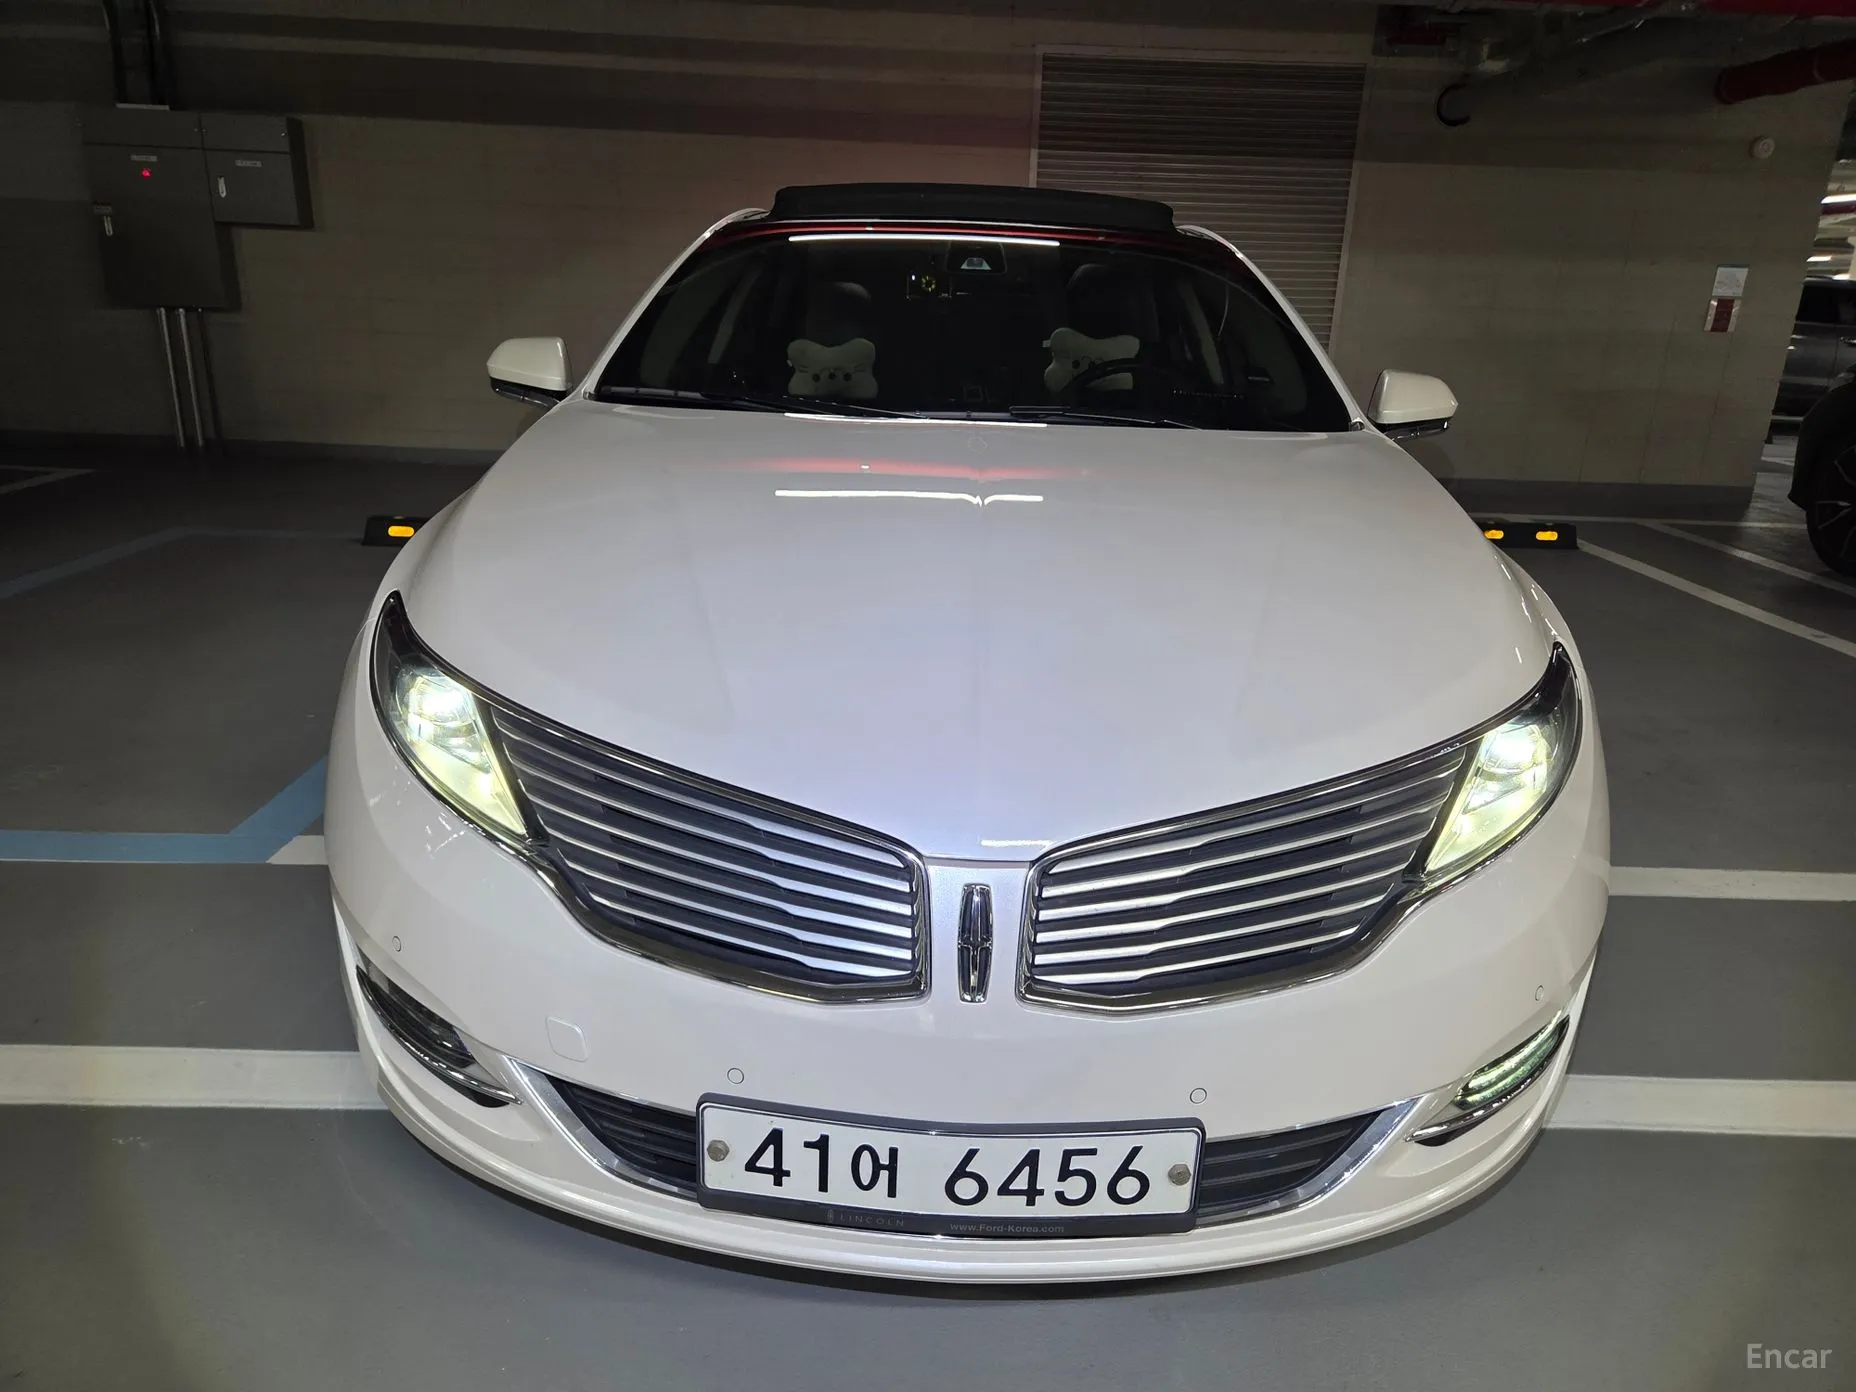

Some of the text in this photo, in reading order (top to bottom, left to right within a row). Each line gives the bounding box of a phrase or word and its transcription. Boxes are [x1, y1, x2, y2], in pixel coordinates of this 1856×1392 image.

[744, 1127, 1150, 1207] 41어 6456
[840, 1212, 904, 1227] LINCOLN
[949, 1223, 1065, 1233] www.Ford-Korea.com
